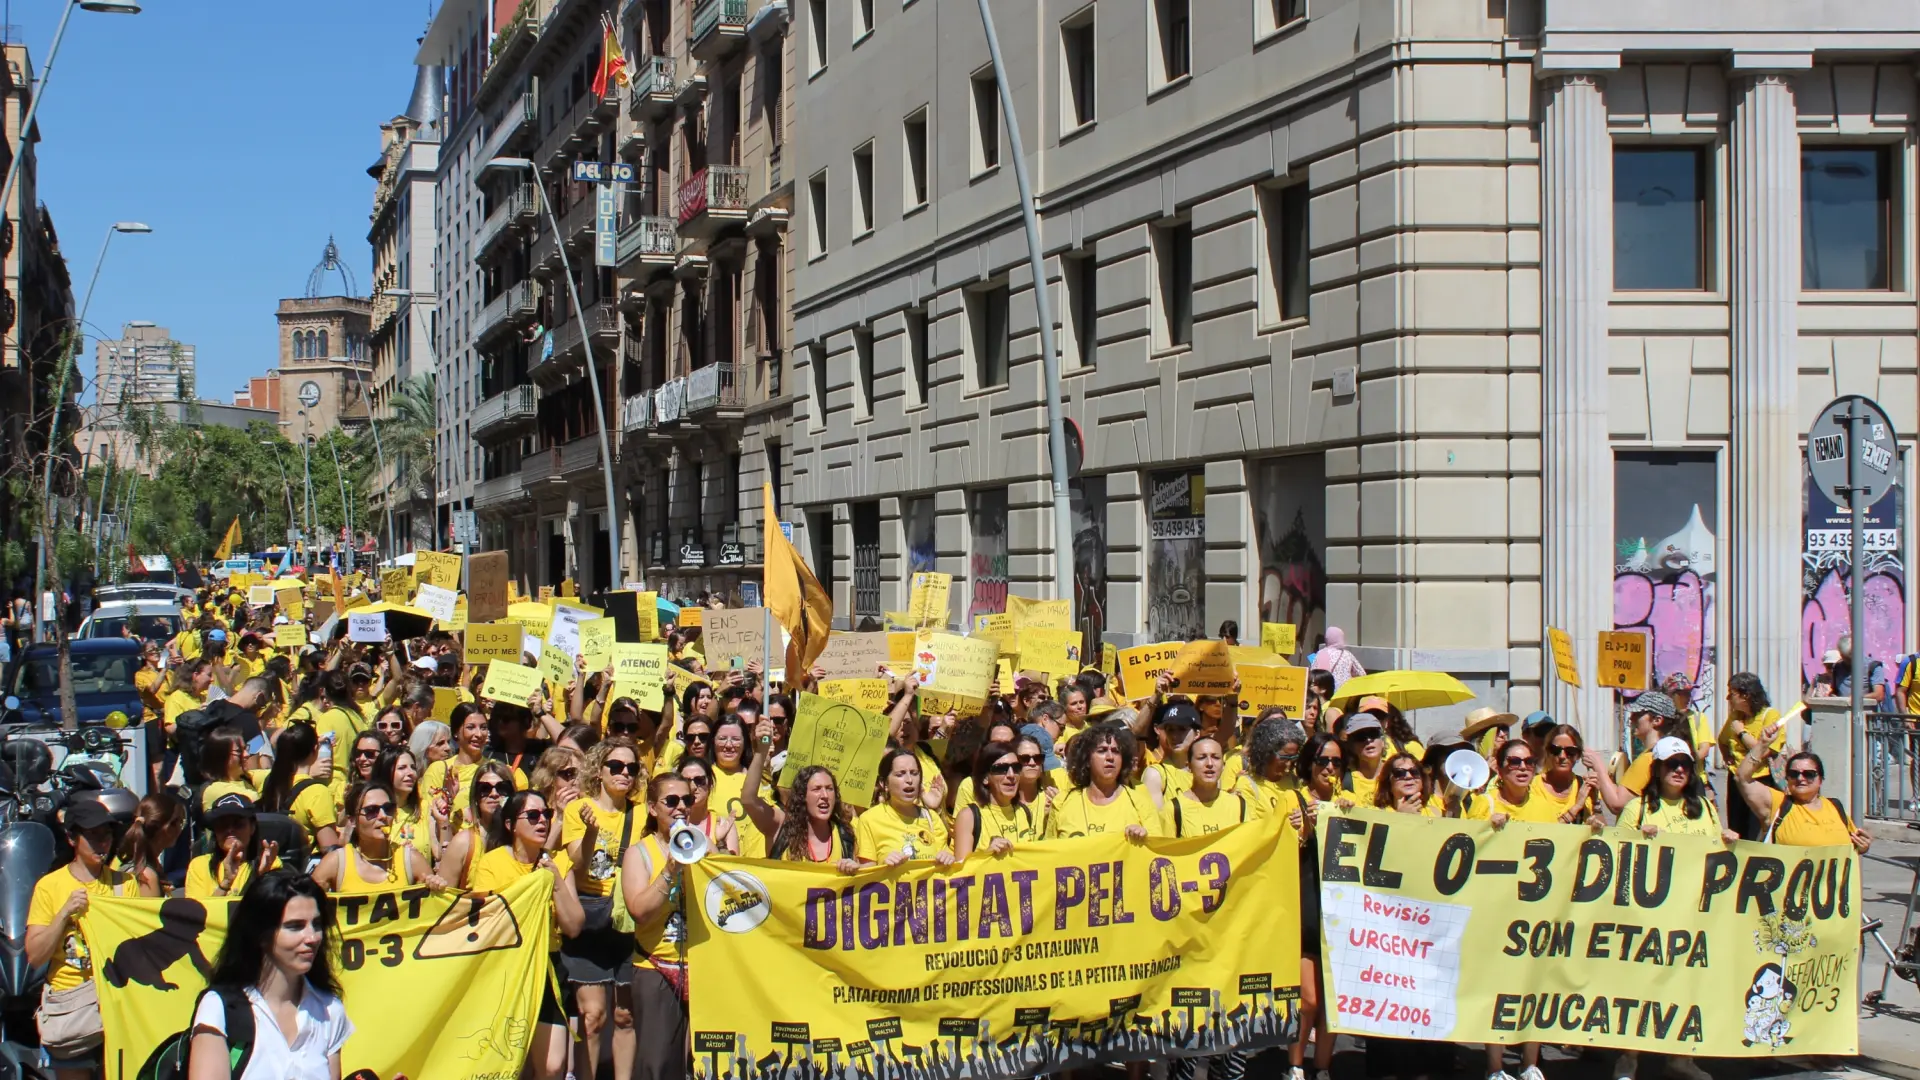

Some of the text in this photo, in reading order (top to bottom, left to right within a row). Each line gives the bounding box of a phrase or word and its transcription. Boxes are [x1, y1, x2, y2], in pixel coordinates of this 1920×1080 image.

[576, 163, 632, 180] PELAYO
[600, 183, 613, 264] HOTEL
[1152, 519, 1205, 536] 93 439 54 5
[1809, 533, 1826, 546] 93
[1879, 533, 1895, 546] 54
[417, 550, 459, 566] DIGNITAT
[431, 564, 441, 574] PEL
[710, 614, 738, 629] ENS
[476, 634, 509, 643] EL 0-3
[710, 631, 766, 645] FALTEN
[1605, 641, 1614, 651] EL
[467, 648, 480, 656] NO
[482, 648, 498, 656] POT
[1129, 656, 1142, 667] EL
[1144, 651, 1162, 663] 0-3
[620, 657, 661, 669] ATENCIÓ
[1613, 660, 1632, 670] PROU
[630, 688, 648, 697] PROU
[1187, 680, 1232, 689] SOUS DIGNES
[512, 692, 528, 702] DIGNE
[822, 728, 845, 742] DECRET
[1088, 823, 1106, 833] Pel
[1202, 824, 1219, 835] Pel
[1322, 816, 1852, 921] EL 0-3 DIU PROU!
[803, 852, 1231, 951] DIGNITAT PEL 0-3
[1364, 894, 1431, 925] Revisió
[1349, 928, 1435, 959] URGENT
[1502, 919, 1708, 968] SOM ETAPA
[341, 933, 404, 971] 0-3
[925, 936, 1099, 972] REVOLUCIÓ 0-3 CATALUNYA
[832, 954, 1182, 1004] PLATAFORMA DE PROFESSIONALS DE LA PETITA INFÀNCIA
[1360, 965, 1416, 990] decret
[1787, 954, 1844, 988] DEFENSEM
[1337, 995, 1432, 1026] 282/2006
[1491, 992, 1703, 1043] EDUCATIVA
[700, 1033, 733, 1041] BAIXADA DE
